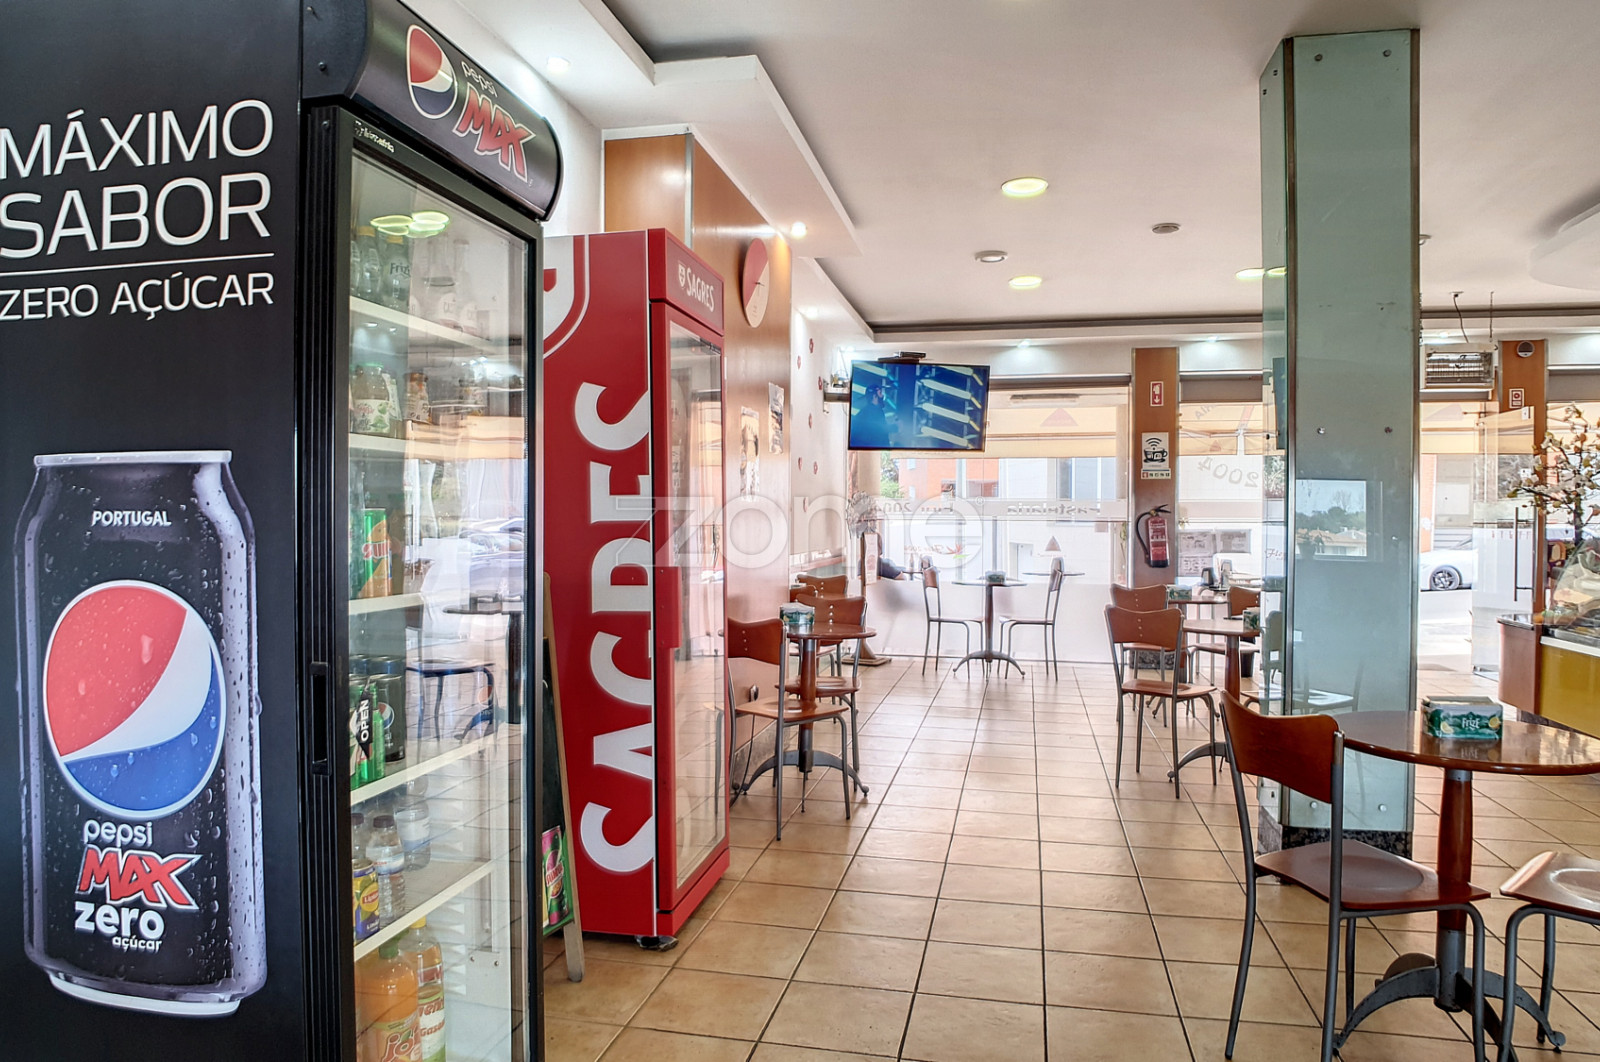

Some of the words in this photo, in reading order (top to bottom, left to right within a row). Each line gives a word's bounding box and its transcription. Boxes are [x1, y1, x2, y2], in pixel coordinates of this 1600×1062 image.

[462, 61, 498, 97] pepsi
[0, 99, 274, 179] MÁXIMO
[452, 82, 536, 183] MAX
[0, 171, 272, 258] SABOR
[0, 283, 99, 320] ZERO
[109, 271, 274, 320] AÇÚCAR
[686, 267, 715, 312] SAGRES
[91, 510, 172, 526] PORTUGAL
[360, 699, 370, 744] OPEN
[83, 819, 153, 848] pepsi
[75, 844, 204, 910] MAX
[74, 901, 165, 940] zero
[112, 934, 163, 952] açúcar
